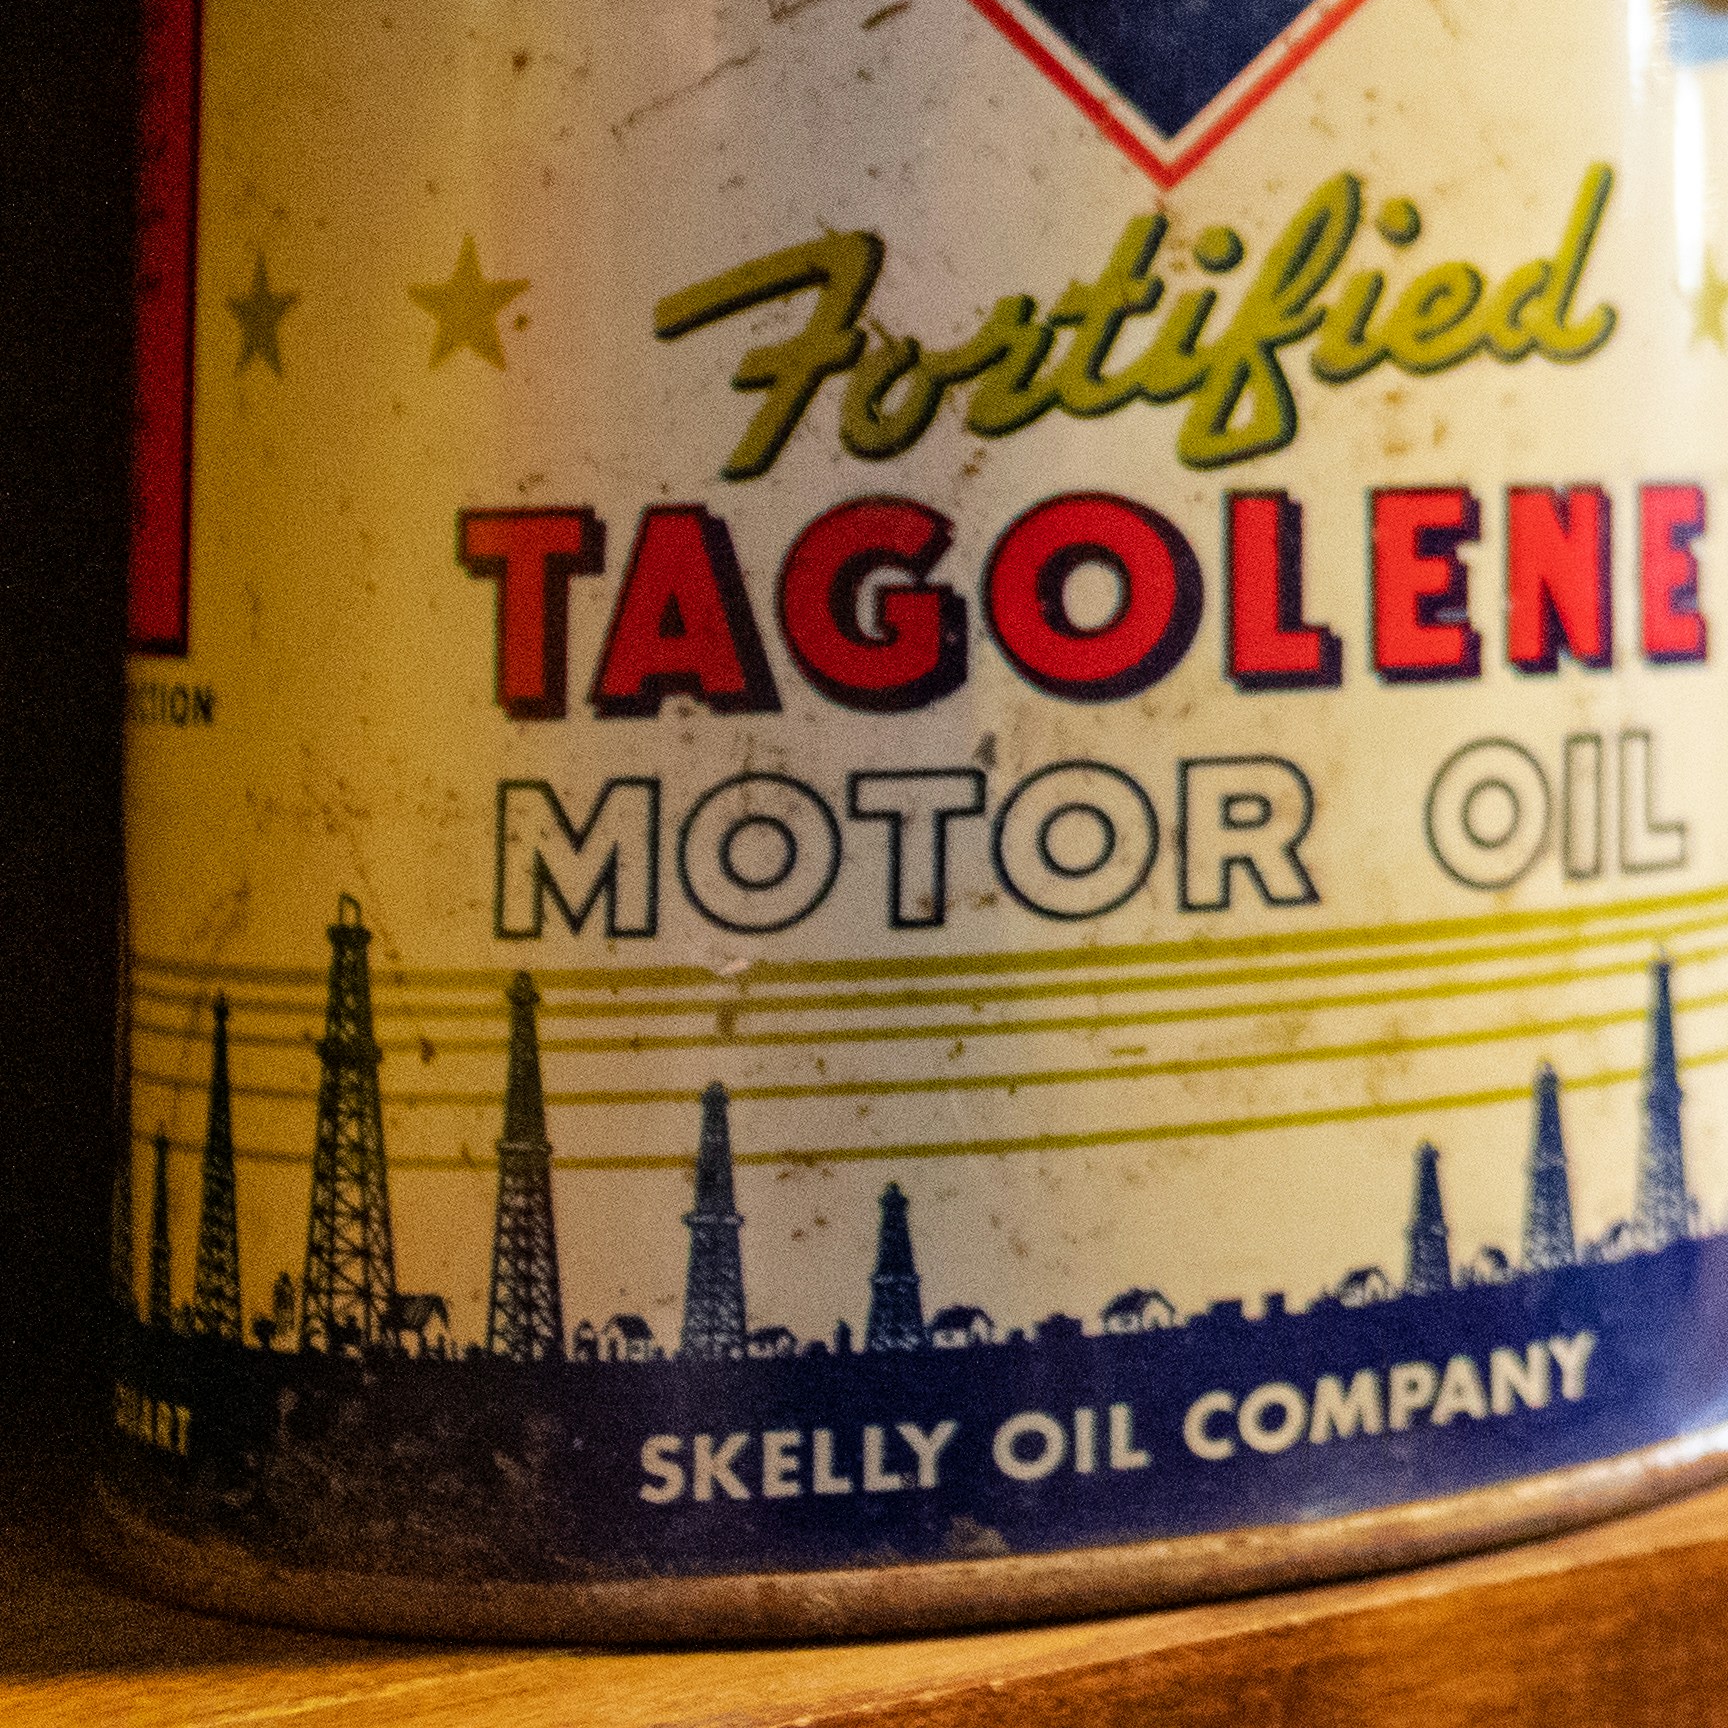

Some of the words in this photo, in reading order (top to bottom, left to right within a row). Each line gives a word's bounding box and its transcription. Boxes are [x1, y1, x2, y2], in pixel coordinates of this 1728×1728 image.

[652, 160, 1616, 480] Fortified
[456, 482, 1710, 721] TAGOLENE
[493, 754, 1321, 941] MOTOR
[1423, 728, 1689, 893] OIL
[639, 1420, 958, 1505] SKELLY
[992, 1401, 1150, 1482] OIL
[1183, 1330, 1597, 1461] COMPANY
